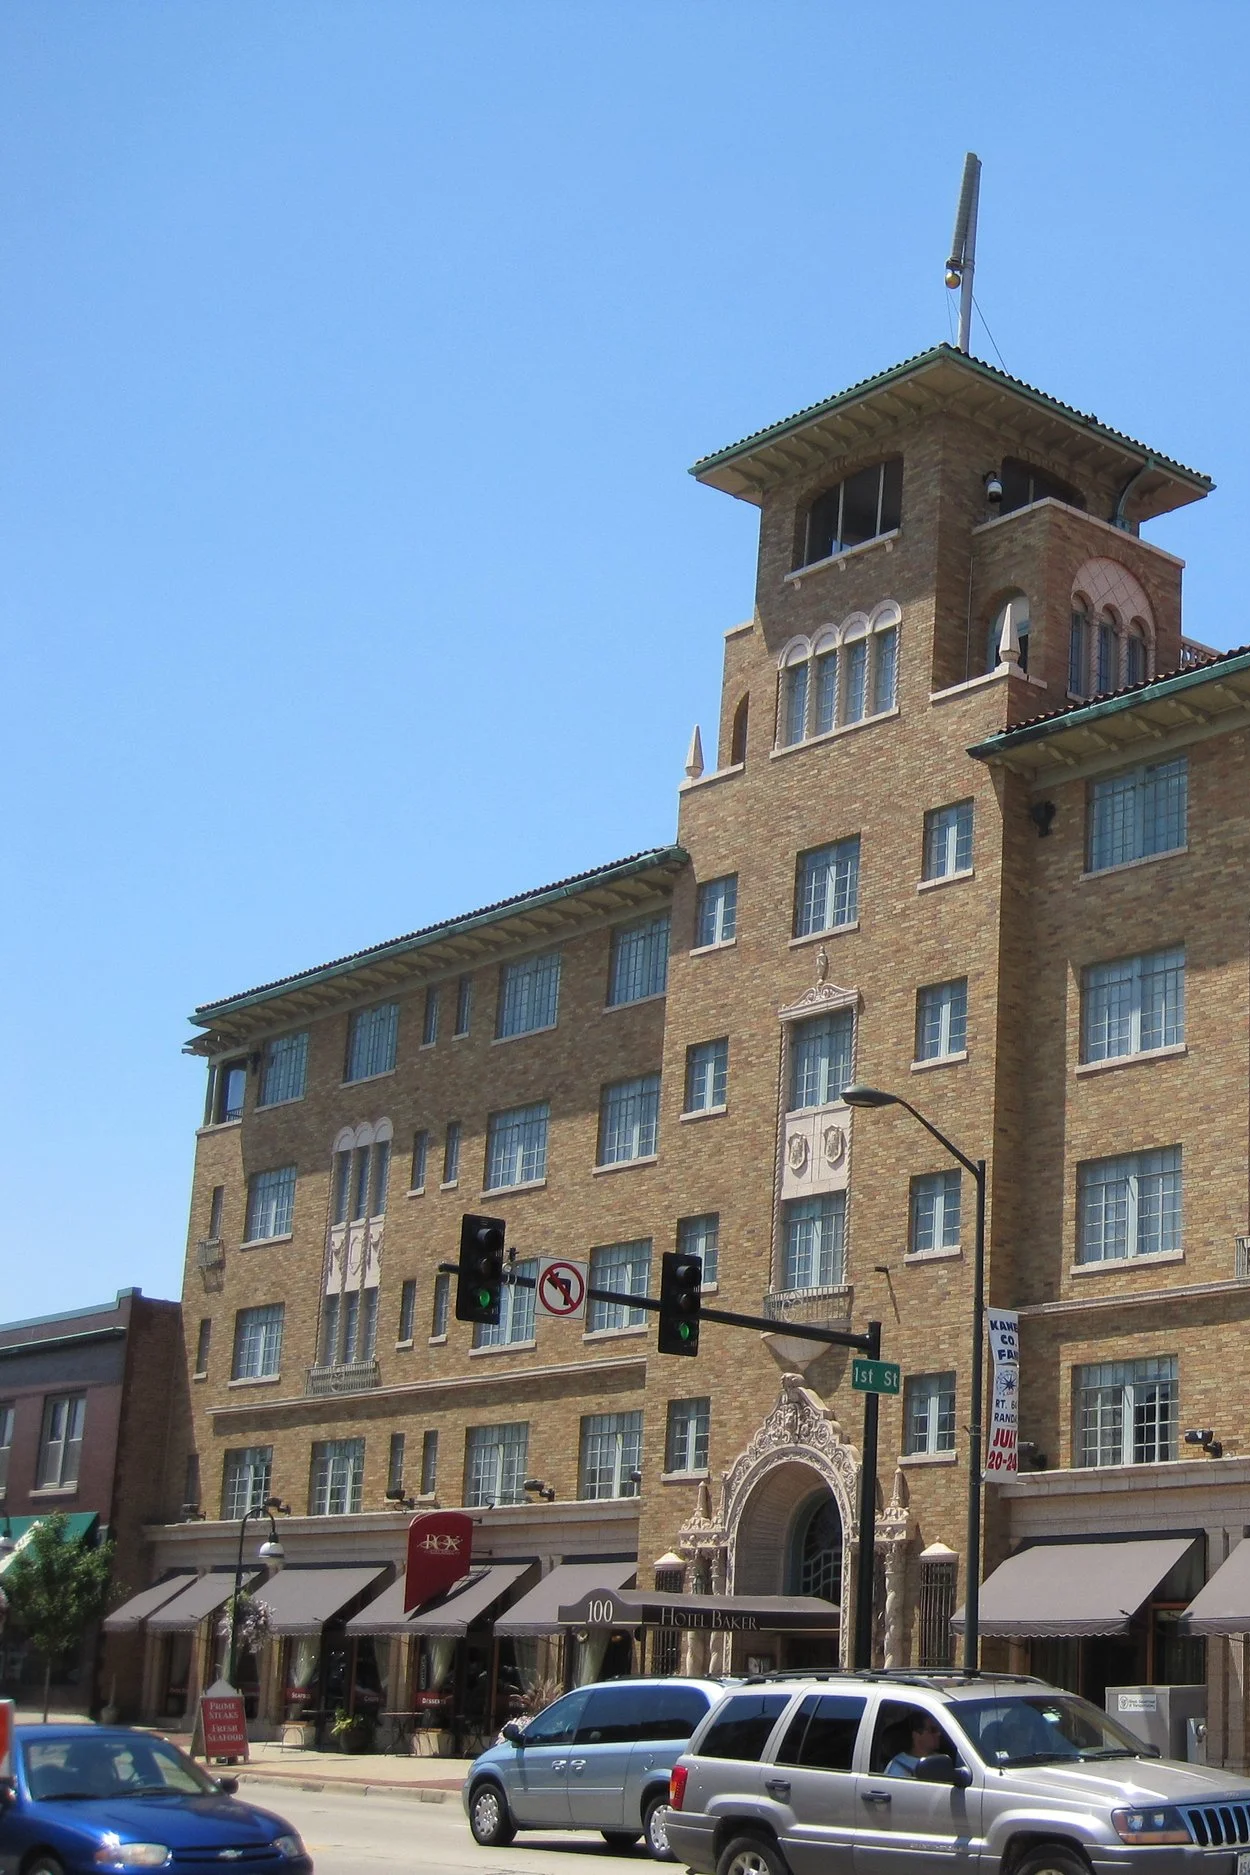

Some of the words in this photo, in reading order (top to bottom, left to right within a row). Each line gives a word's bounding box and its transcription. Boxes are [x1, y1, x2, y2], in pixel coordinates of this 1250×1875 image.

[989, 1320, 1018, 1333] KANE
[1001, 1334, 1017, 1347] CO.
[855, 1367, 873, 1384] 1st
[884, 1371, 898, 1388] St
[587, 1600, 614, 1623] 100
[661, 1607, 707, 1627] HOTEL
[712, 1610, 758, 1631] BAKER
